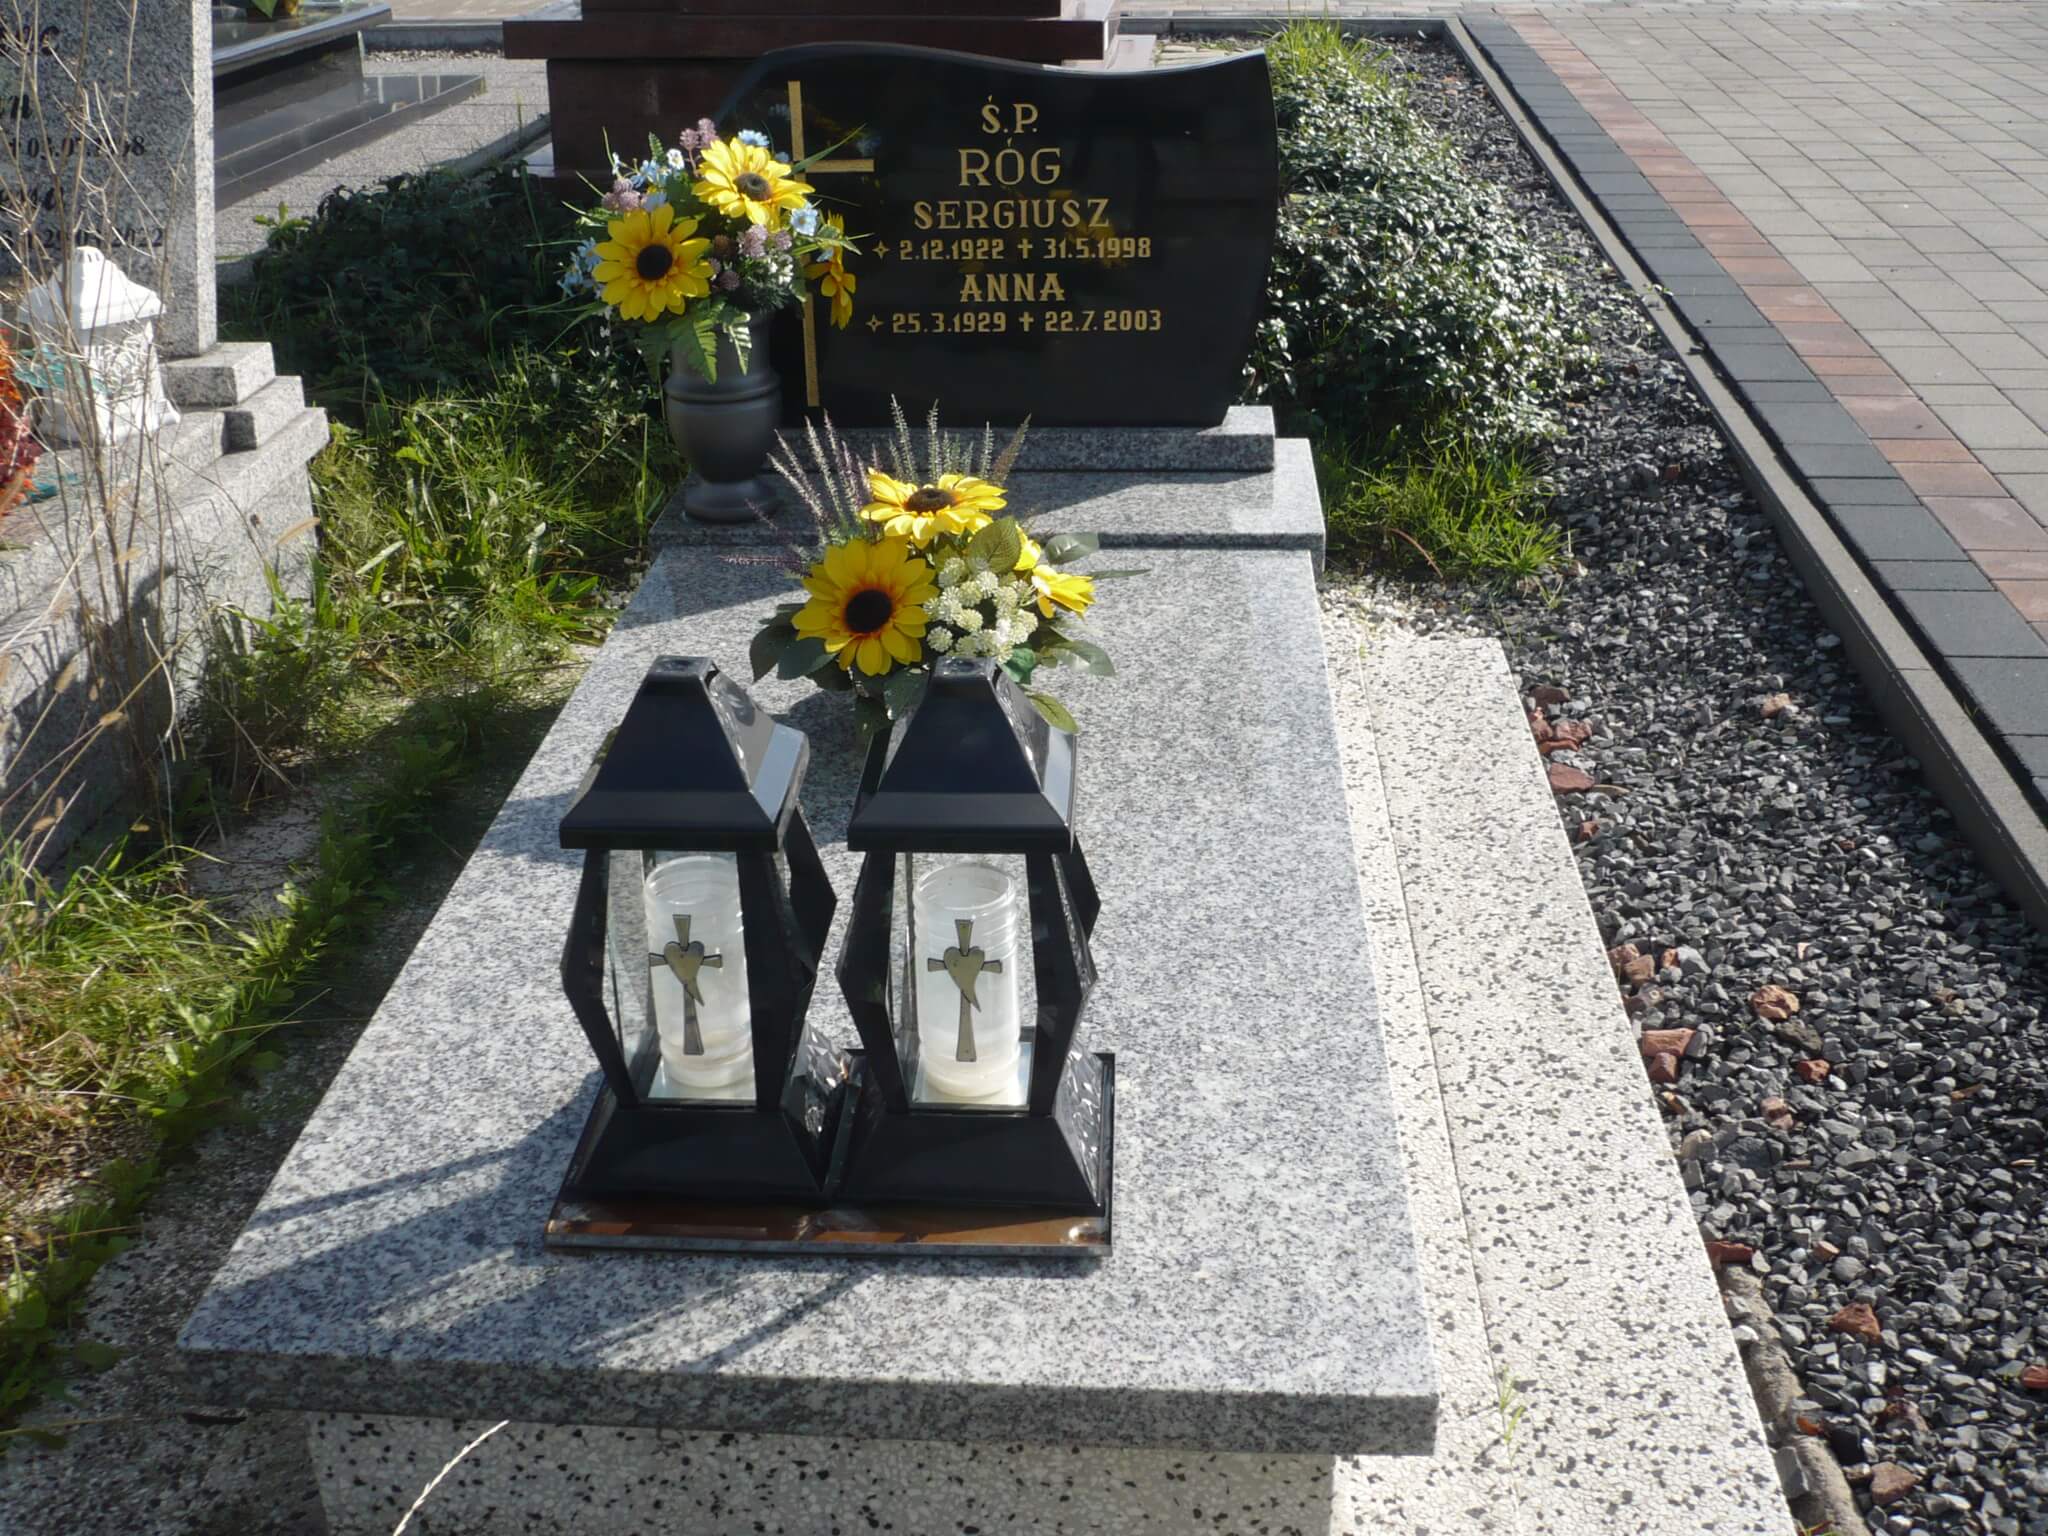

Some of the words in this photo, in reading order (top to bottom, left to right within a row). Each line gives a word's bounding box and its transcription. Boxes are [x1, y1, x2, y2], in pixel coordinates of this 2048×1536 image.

[981, 95, 1039, 134] Ś.P.
[958, 137, 1061, 186] RÓG
[913, 198, 1111, 230] SERGIUSZ
[900, 238, 1004, 260] 2.12.1922
[1043, 237, 1151, 259] 31.5.1998
[959, 272, 1065, 303] ANNA
[892, 311, 1006, 333] 25.3.1929
